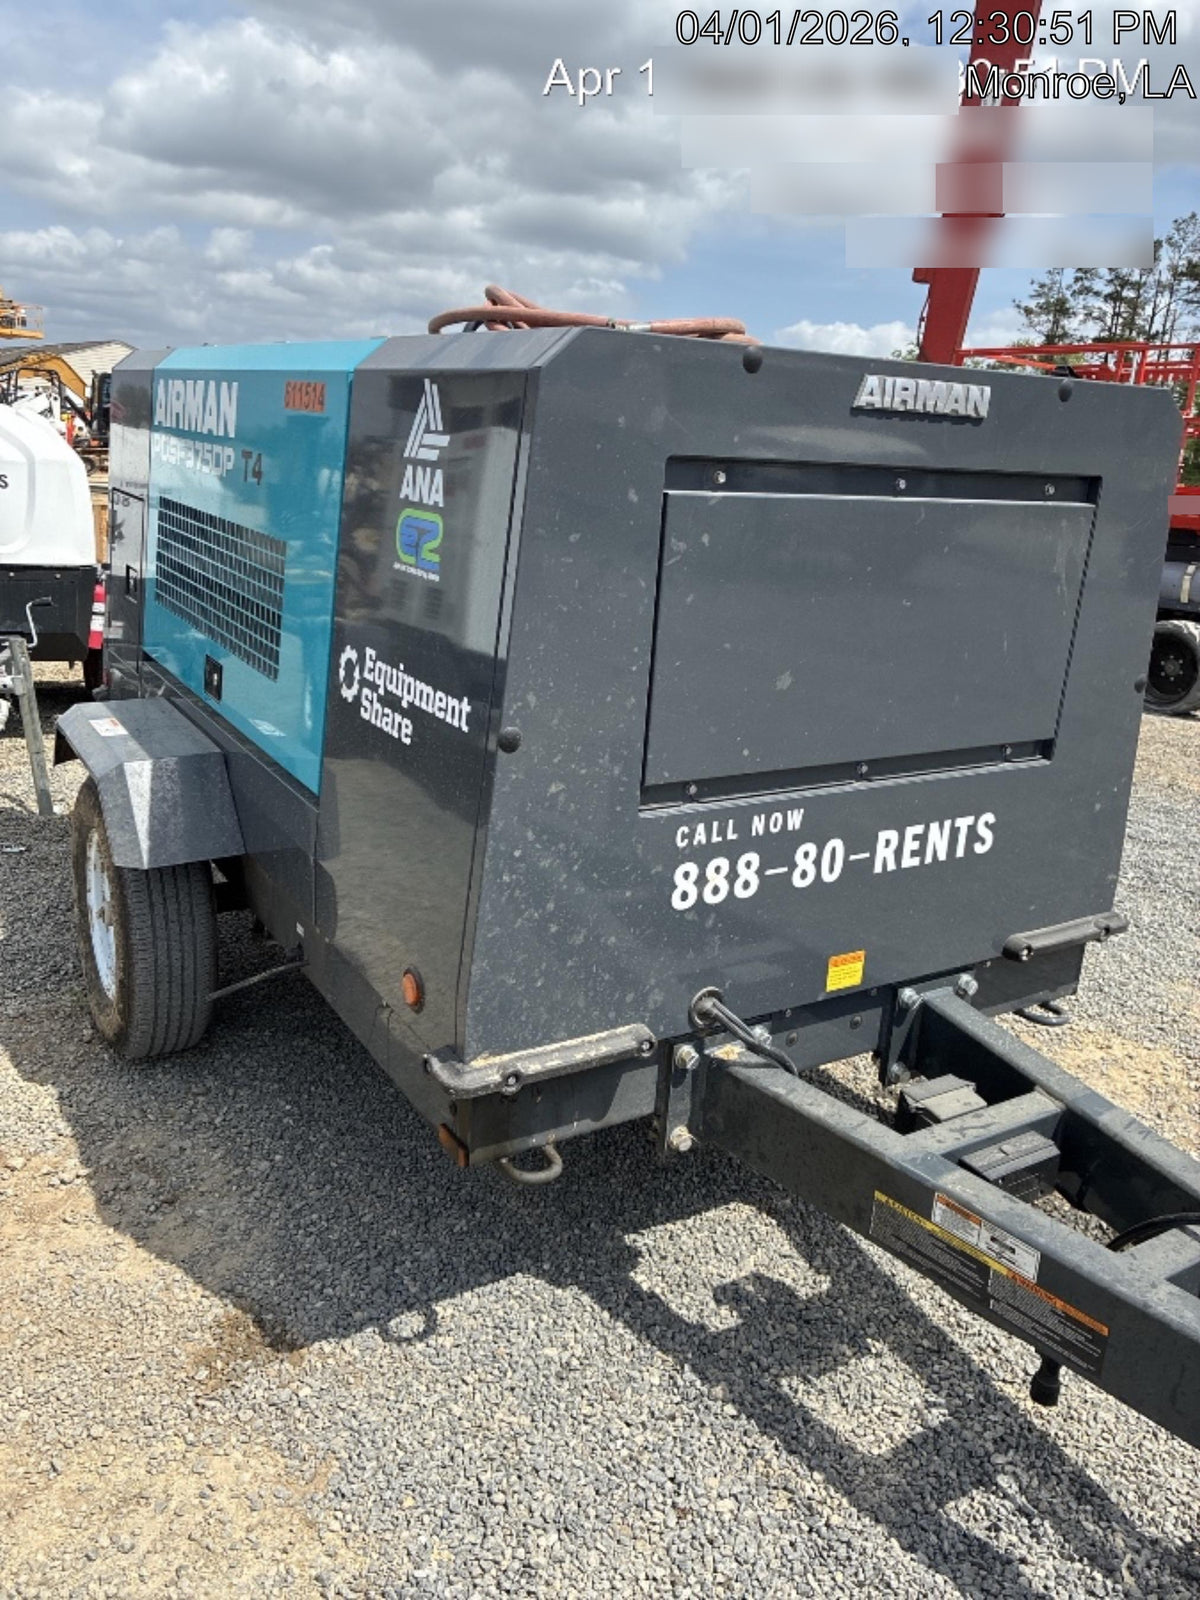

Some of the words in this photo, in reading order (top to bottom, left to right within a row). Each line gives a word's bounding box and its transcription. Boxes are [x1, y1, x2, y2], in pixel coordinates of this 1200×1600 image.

[154, 378, 239, 439] AIRMAN
[852, 374, 991, 418] AIRMAN
[241, 448, 264, 486] T4
[400, 464, 445, 508] ANA
[363, 646, 472, 733] Equipment
[360, 687, 413, 745] Share
[675, 818, 738, 848] CALL
[751, 808, 805, 837] NOW
[671, 812, 996, 911] 888-80-RENTS
